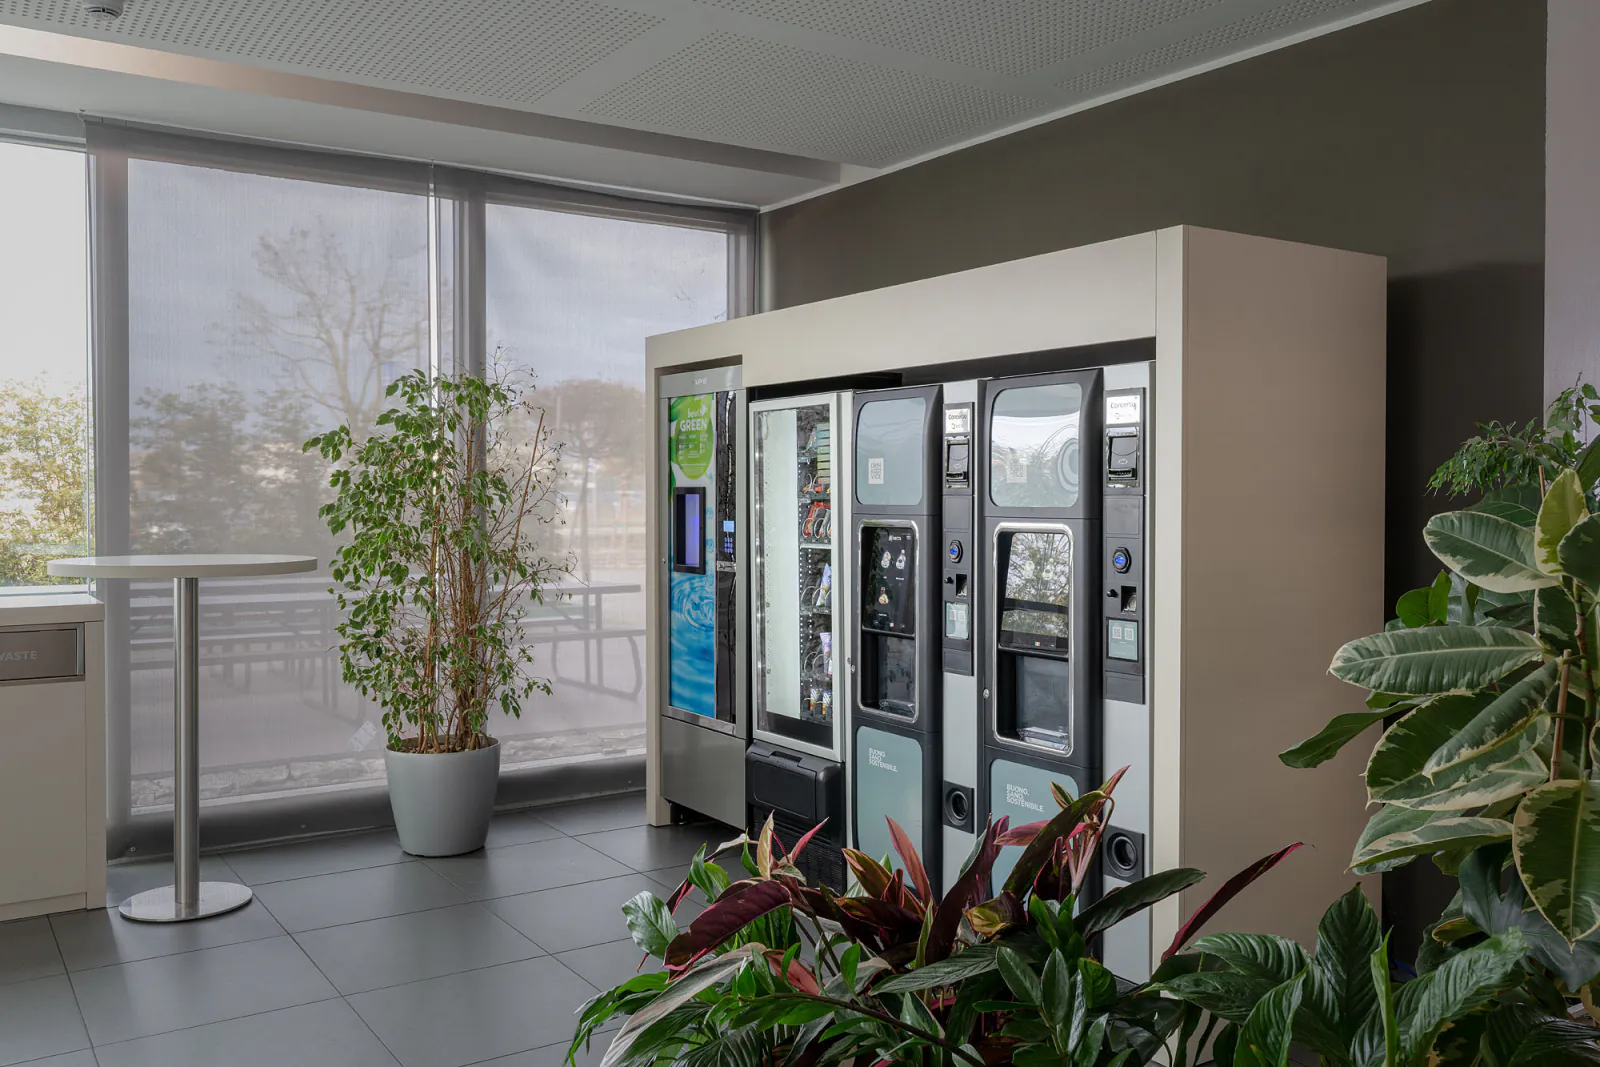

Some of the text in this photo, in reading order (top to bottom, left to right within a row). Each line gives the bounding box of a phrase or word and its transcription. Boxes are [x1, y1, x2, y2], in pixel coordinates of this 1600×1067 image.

[680, 418, 707, 432] GREEN
[1006, 783, 1030, 796] BUONO.
[1006, 796, 1045, 813] SOSTENIBILE.
